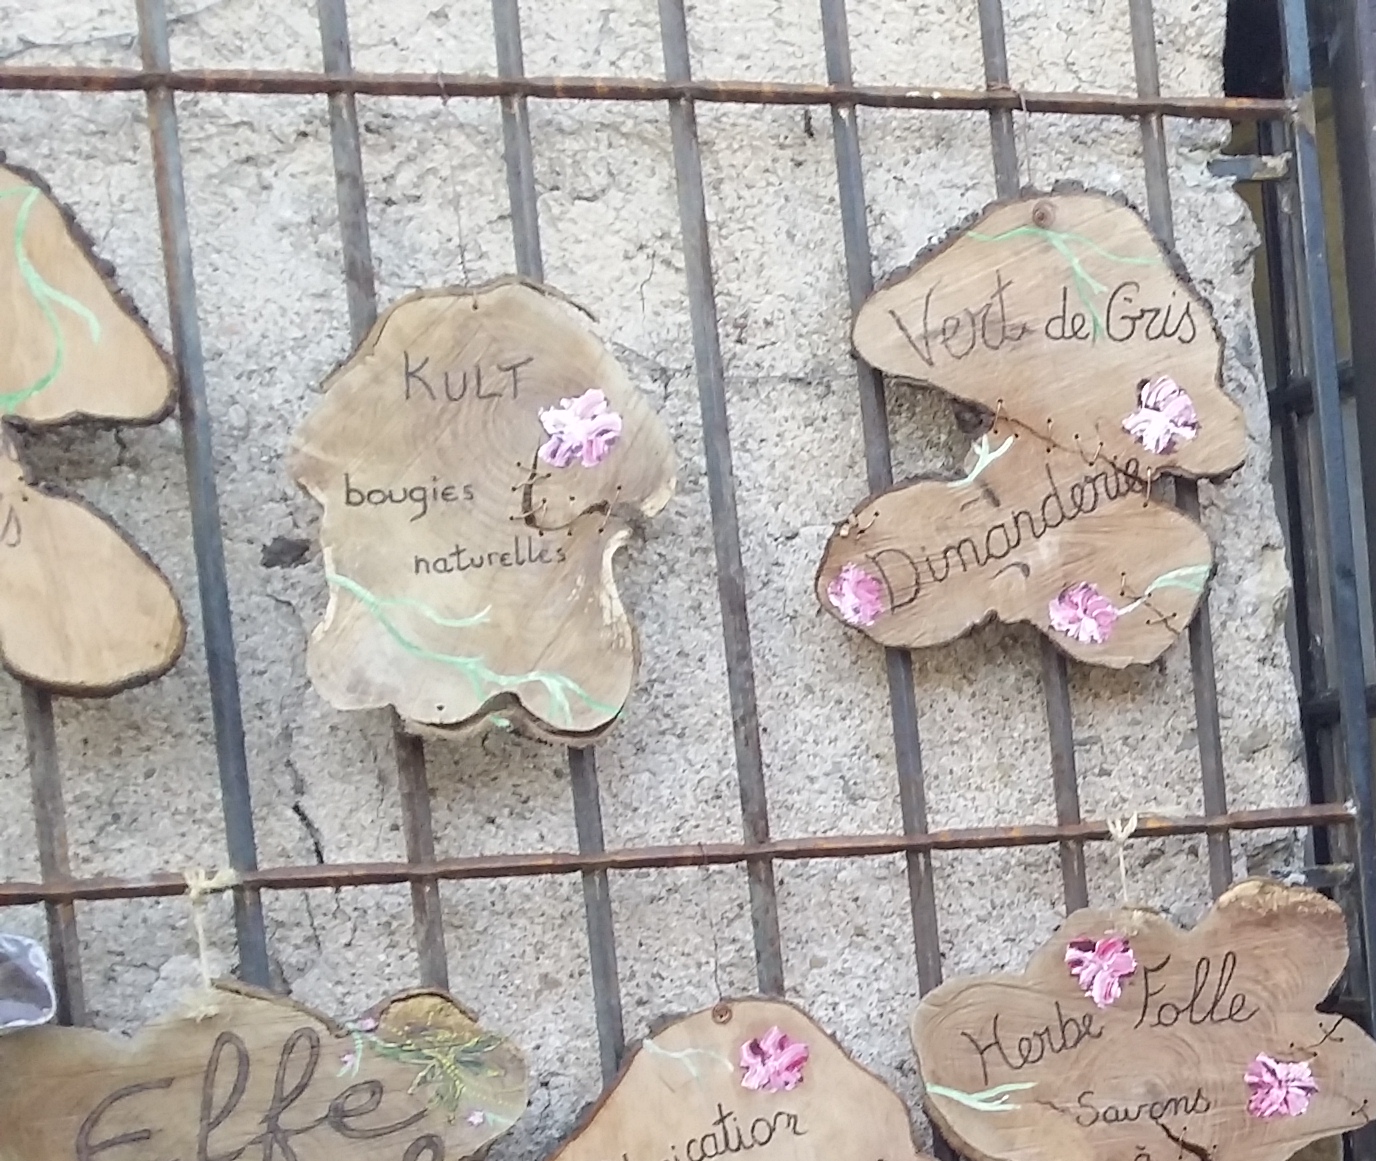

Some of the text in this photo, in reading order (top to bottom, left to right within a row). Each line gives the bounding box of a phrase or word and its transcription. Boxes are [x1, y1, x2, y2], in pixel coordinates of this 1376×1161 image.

[888, 269, 1197, 367] Vert de Gris
[403, 352, 534, 400] KULT
[344, 474, 475, 522] bougies
[414, 536, 567, 575] naturelles
[961, 951, 1261, 1085] Herbe Folle
[1076, 1087, 1211, 1127] Savons
